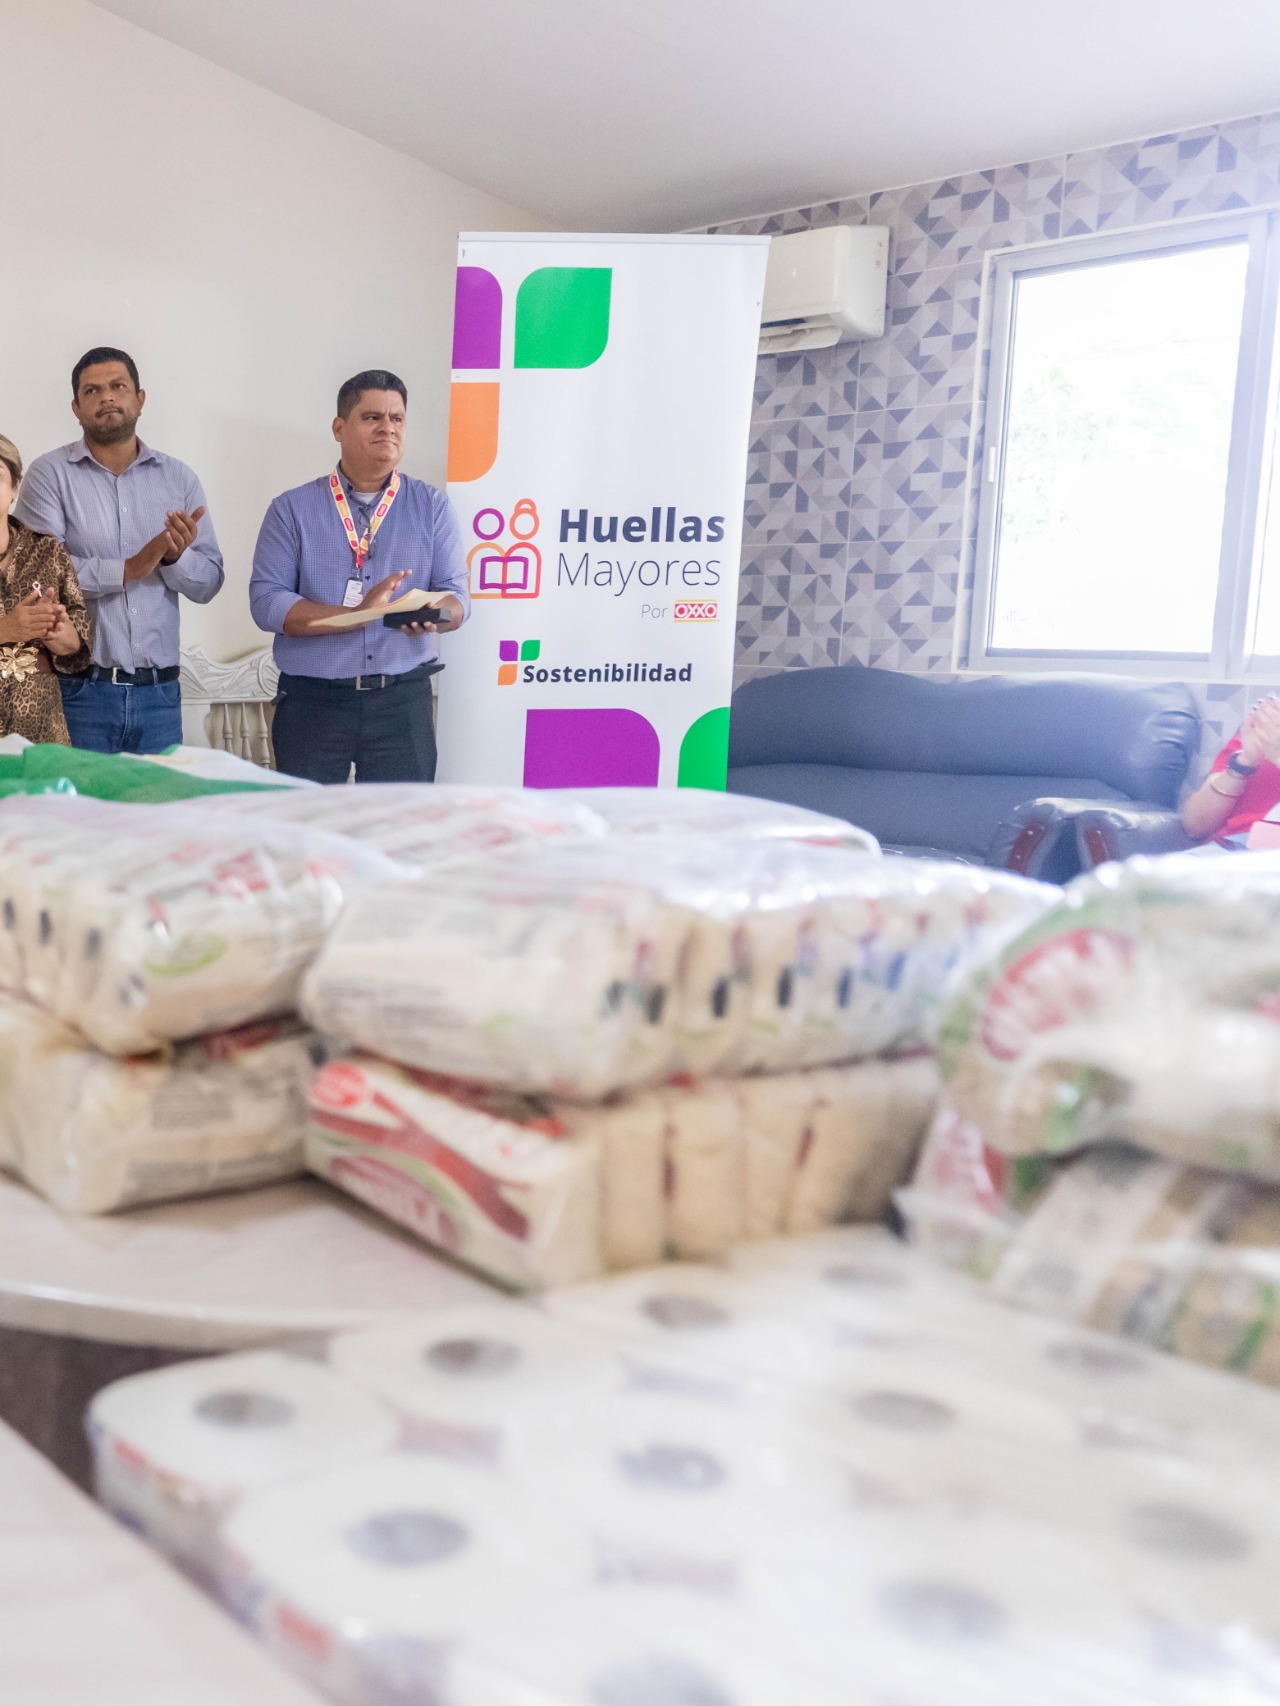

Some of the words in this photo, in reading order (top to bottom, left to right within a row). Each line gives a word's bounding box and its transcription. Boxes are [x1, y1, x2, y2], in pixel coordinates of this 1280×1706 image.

[559, 506, 725, 543] Huellas
[557, 552, 721, 597] Mayores
[641, 604, 669, 619] Por
[674, 603, 718, 619] OXXO
[522, 663, 693, 683] Sostenibilidad
